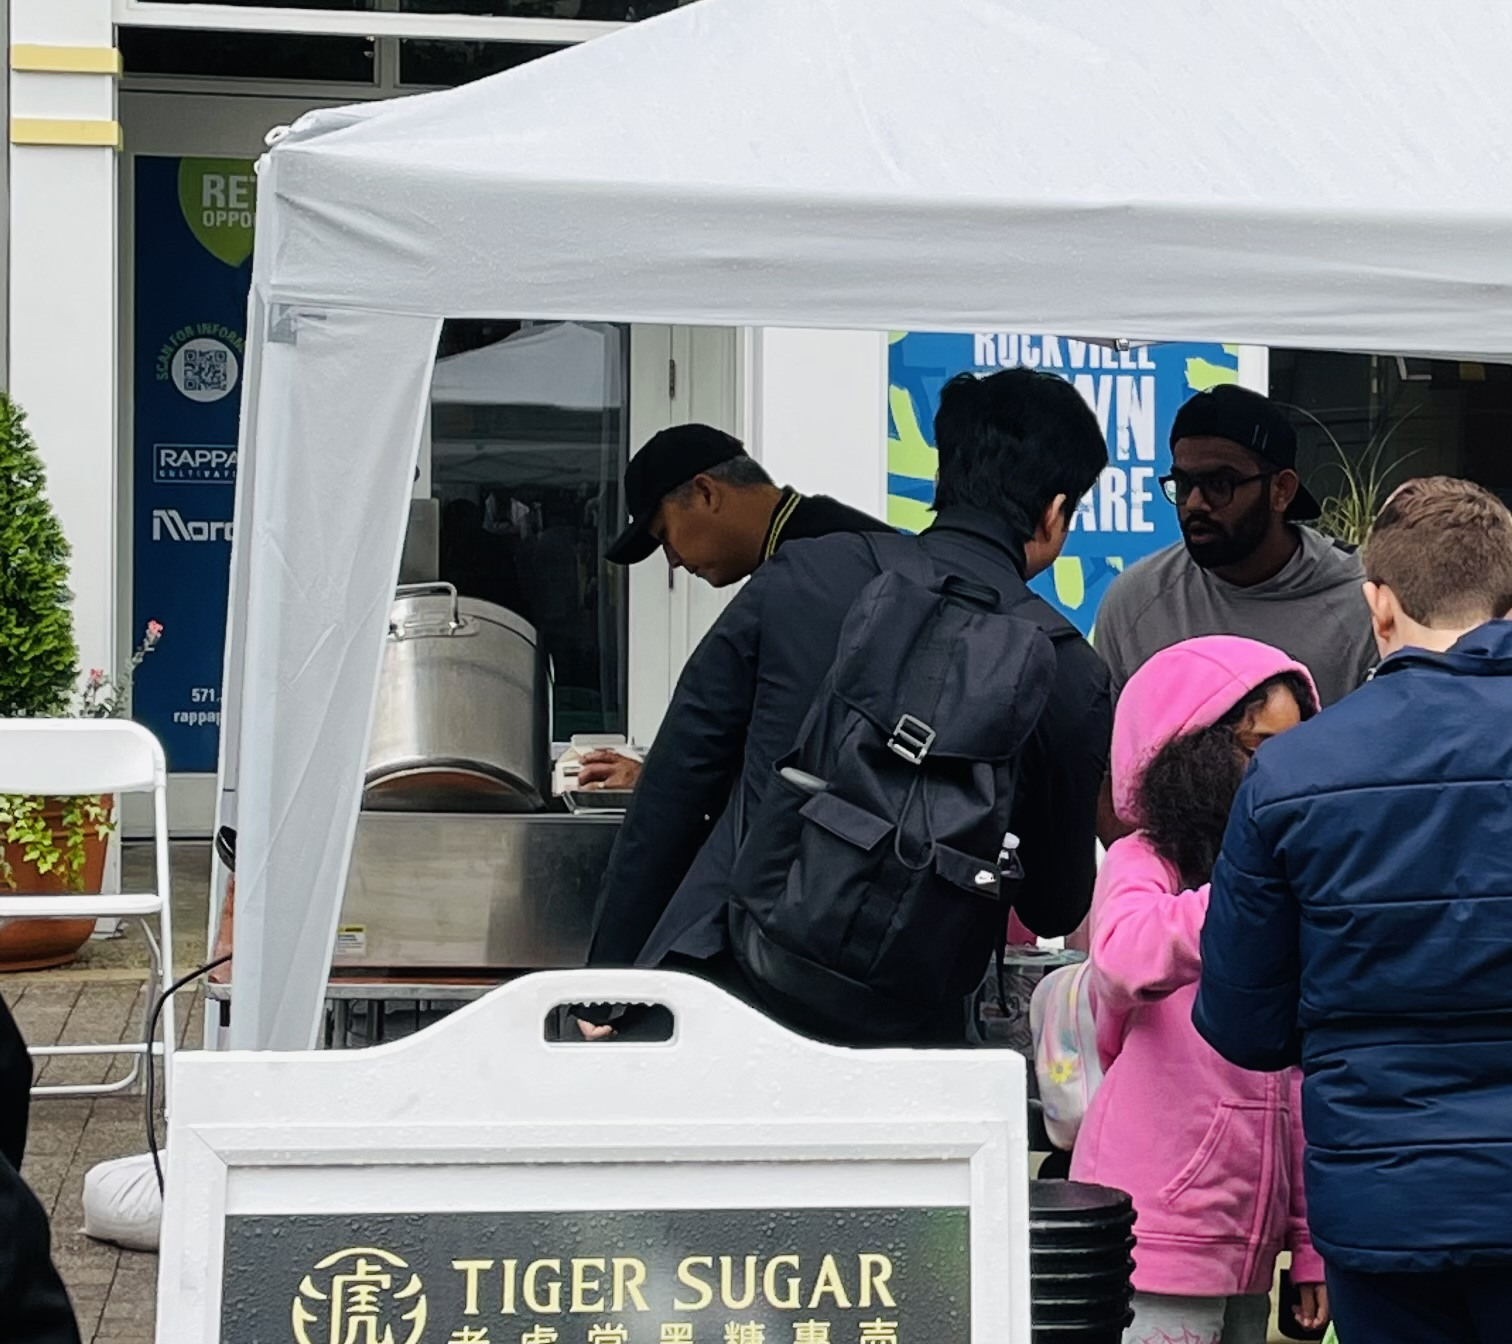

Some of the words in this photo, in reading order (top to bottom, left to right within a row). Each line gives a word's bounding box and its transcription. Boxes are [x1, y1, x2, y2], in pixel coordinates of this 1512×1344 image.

[202, 210, 255, 229] OPPO
[450, 1256, 651, 1316] TIGER
[673, 1252, 898, 1312] SUGAR
